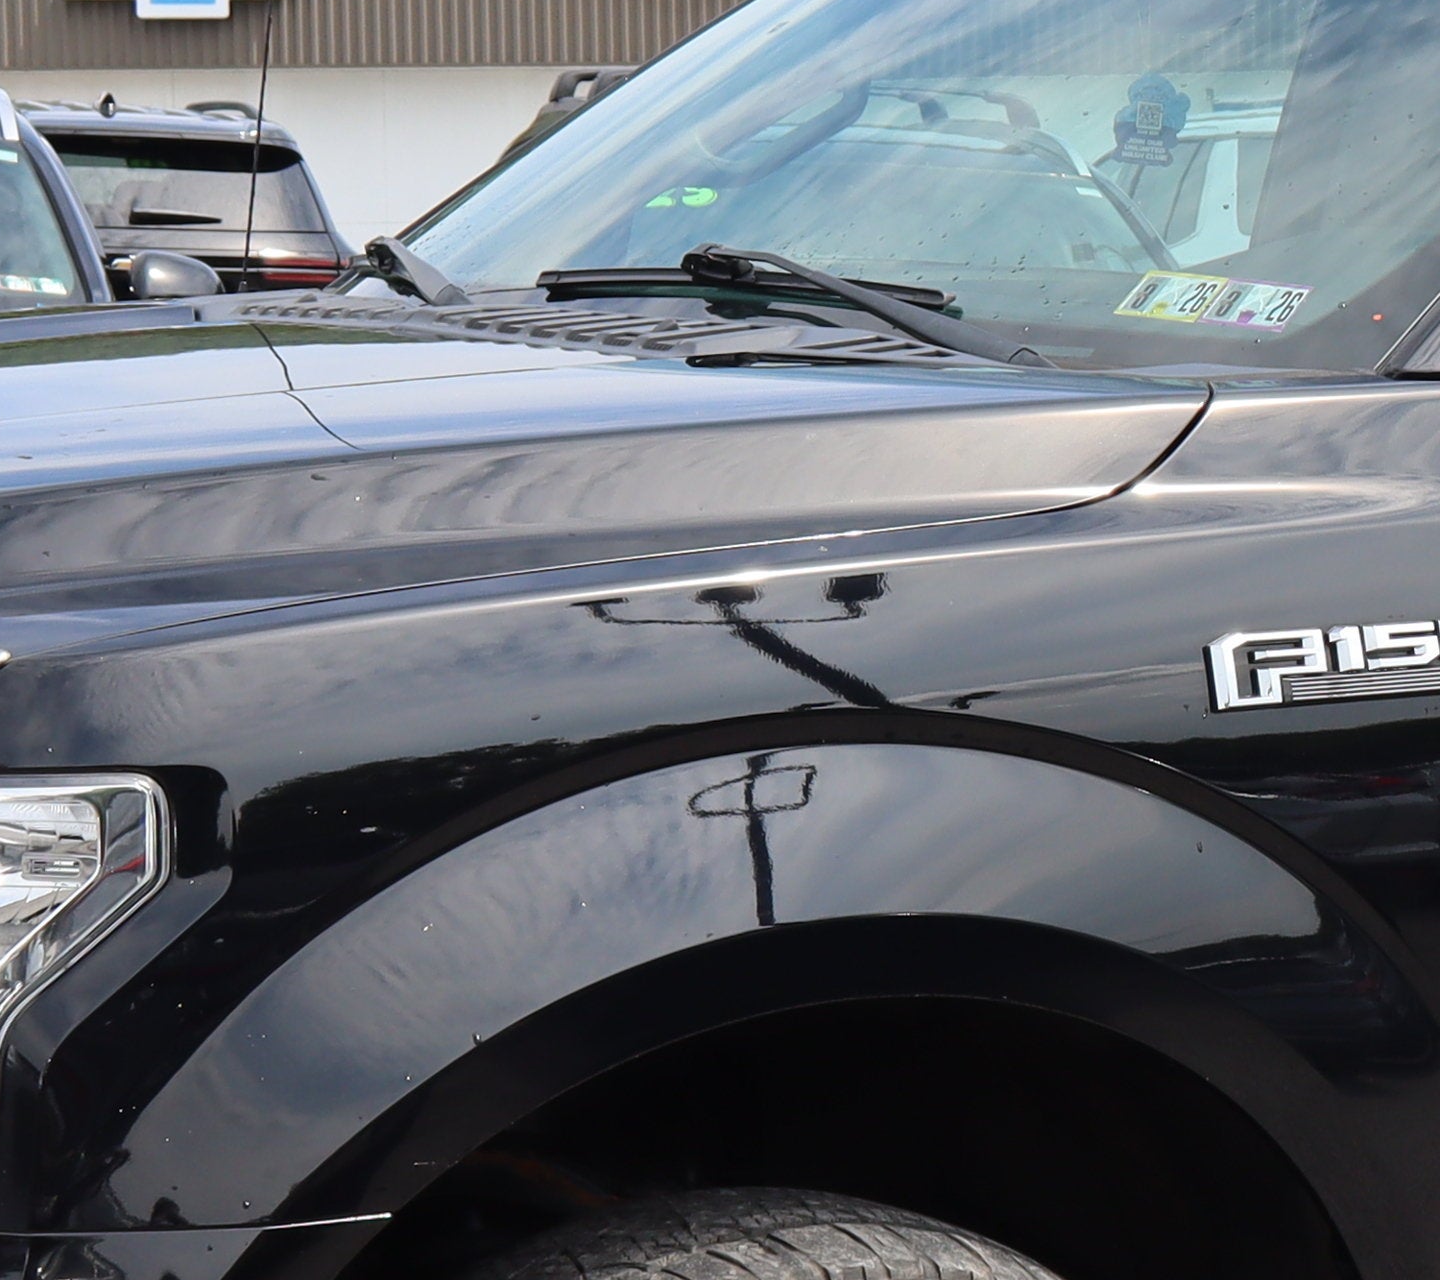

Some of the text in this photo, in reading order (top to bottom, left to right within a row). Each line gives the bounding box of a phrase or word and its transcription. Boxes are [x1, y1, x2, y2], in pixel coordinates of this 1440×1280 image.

[1131, 282, 1217, 316] 3 26
[1215, 290, 1304, 324] 3 26
